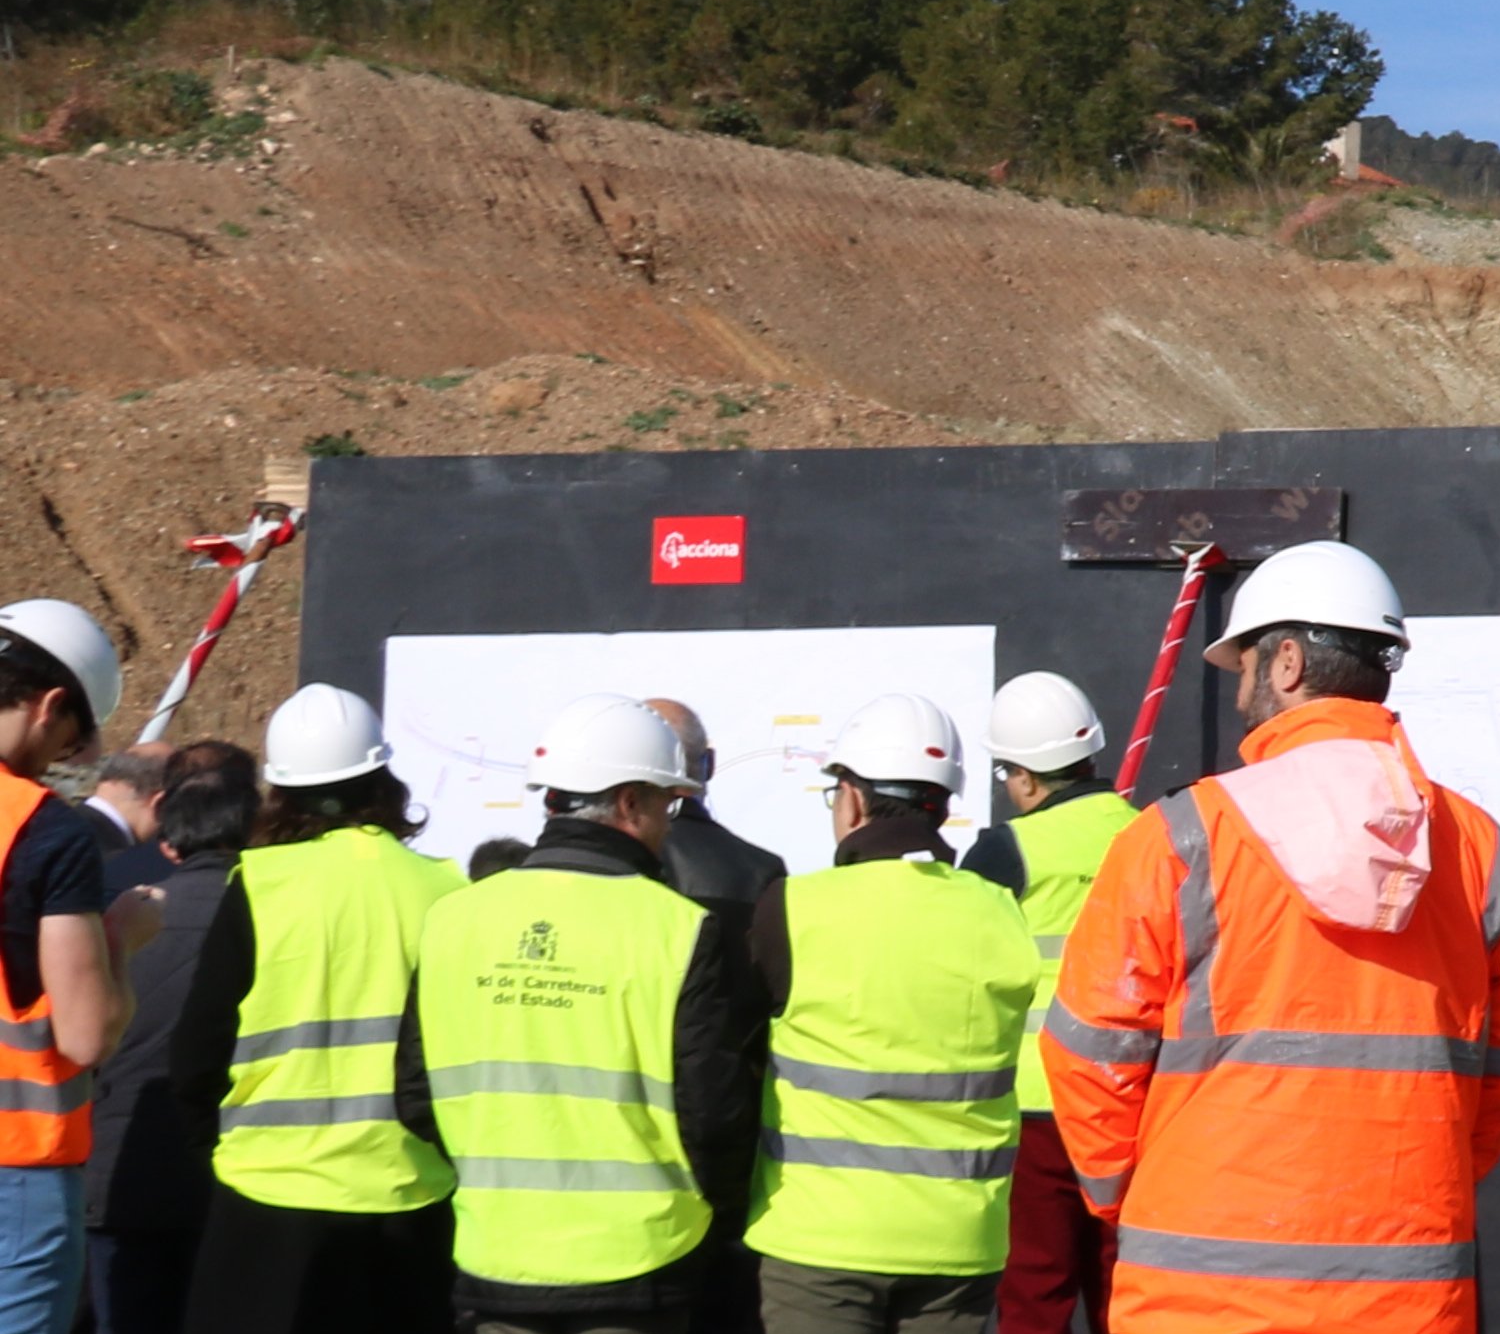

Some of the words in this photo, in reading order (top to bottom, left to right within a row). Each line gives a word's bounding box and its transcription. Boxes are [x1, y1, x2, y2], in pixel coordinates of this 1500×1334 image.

[677, 539, 739, 558] acciona
[497, 975, 515, 988] de
[523, 975, 607, 996] Carreteras
[520, 992, 574, 1009] Estado
